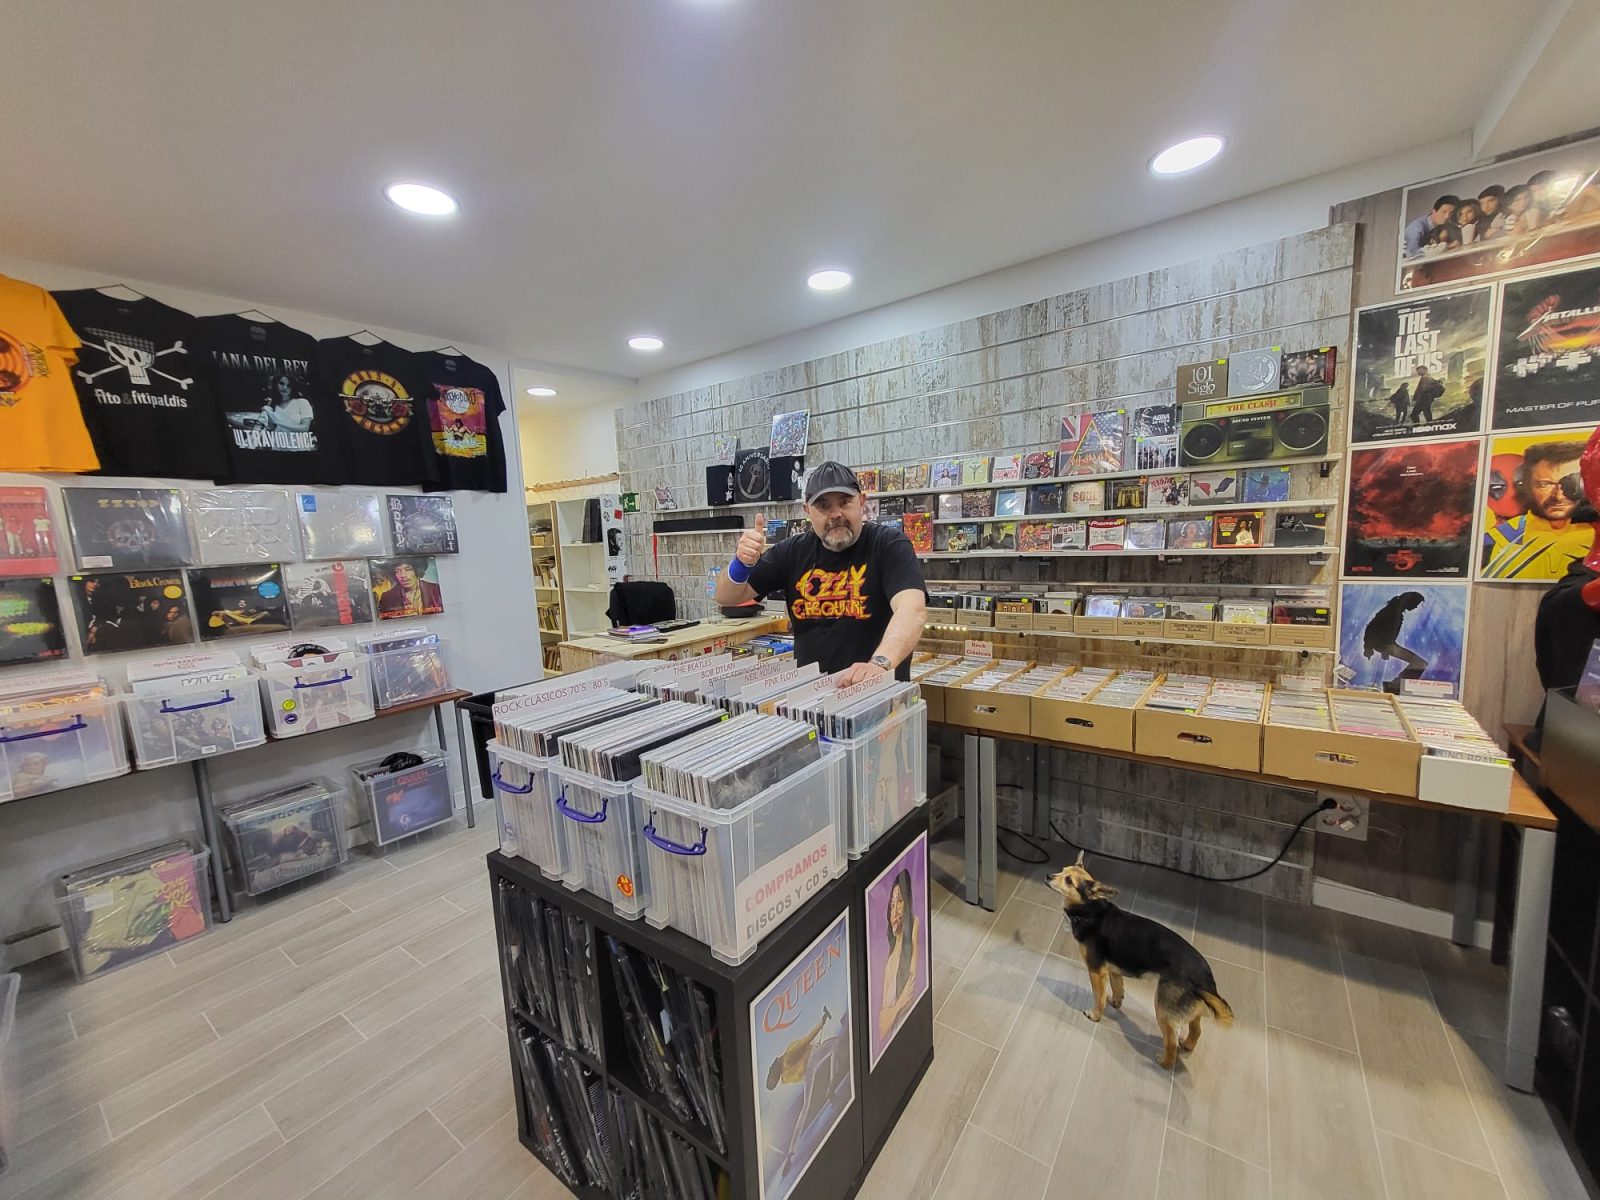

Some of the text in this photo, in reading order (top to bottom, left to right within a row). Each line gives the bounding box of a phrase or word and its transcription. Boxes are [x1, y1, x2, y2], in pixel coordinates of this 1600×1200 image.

[1398, 310, 1430, 336] THE
[1395, 330, 1440, 357] LAST
[212, 350, 308, 375] LANA DEL REY
[1192, 365, 1214, 382] 101
[1394, 351, 1443, 378] OF US
[94, 388, 121, 404] Fito
[131, 390, 188, 408] fitipaldis
[1187, 381, 1216, 395] Siglo
[1227, 399, 1277, 412] THE CLASH
[1506, 402, 1556, 414] MASTER
[1557, 401, 1575, 409] OF
[232, 428, 316, 450] ULTRAVIOLENCE
[795, 563, 870, 600] OZZY
[673, 665, 687, 675] THE
[687, 660, 712, 672] BEATLES
[701, 669, 715, 679] BOB
[715, 662, 736, 675] DYLAN
[744, 665, 781, 683] NEIL YOUNG
[764, 670, 799, 687] PINK FLOYD
[813, 677, 833, 690] QUEEN
[836, 675, 883, 701] ROLLING STONES
[494, 701, 522, 716] ROCK
[570, 682, 587, 695] 70'S
[744, 843, 828, 913] COMPRAMOS
[746, 866, 829, 940] DISCOS Y CD'S
[762, 934, 842, 1034] QUEEN
